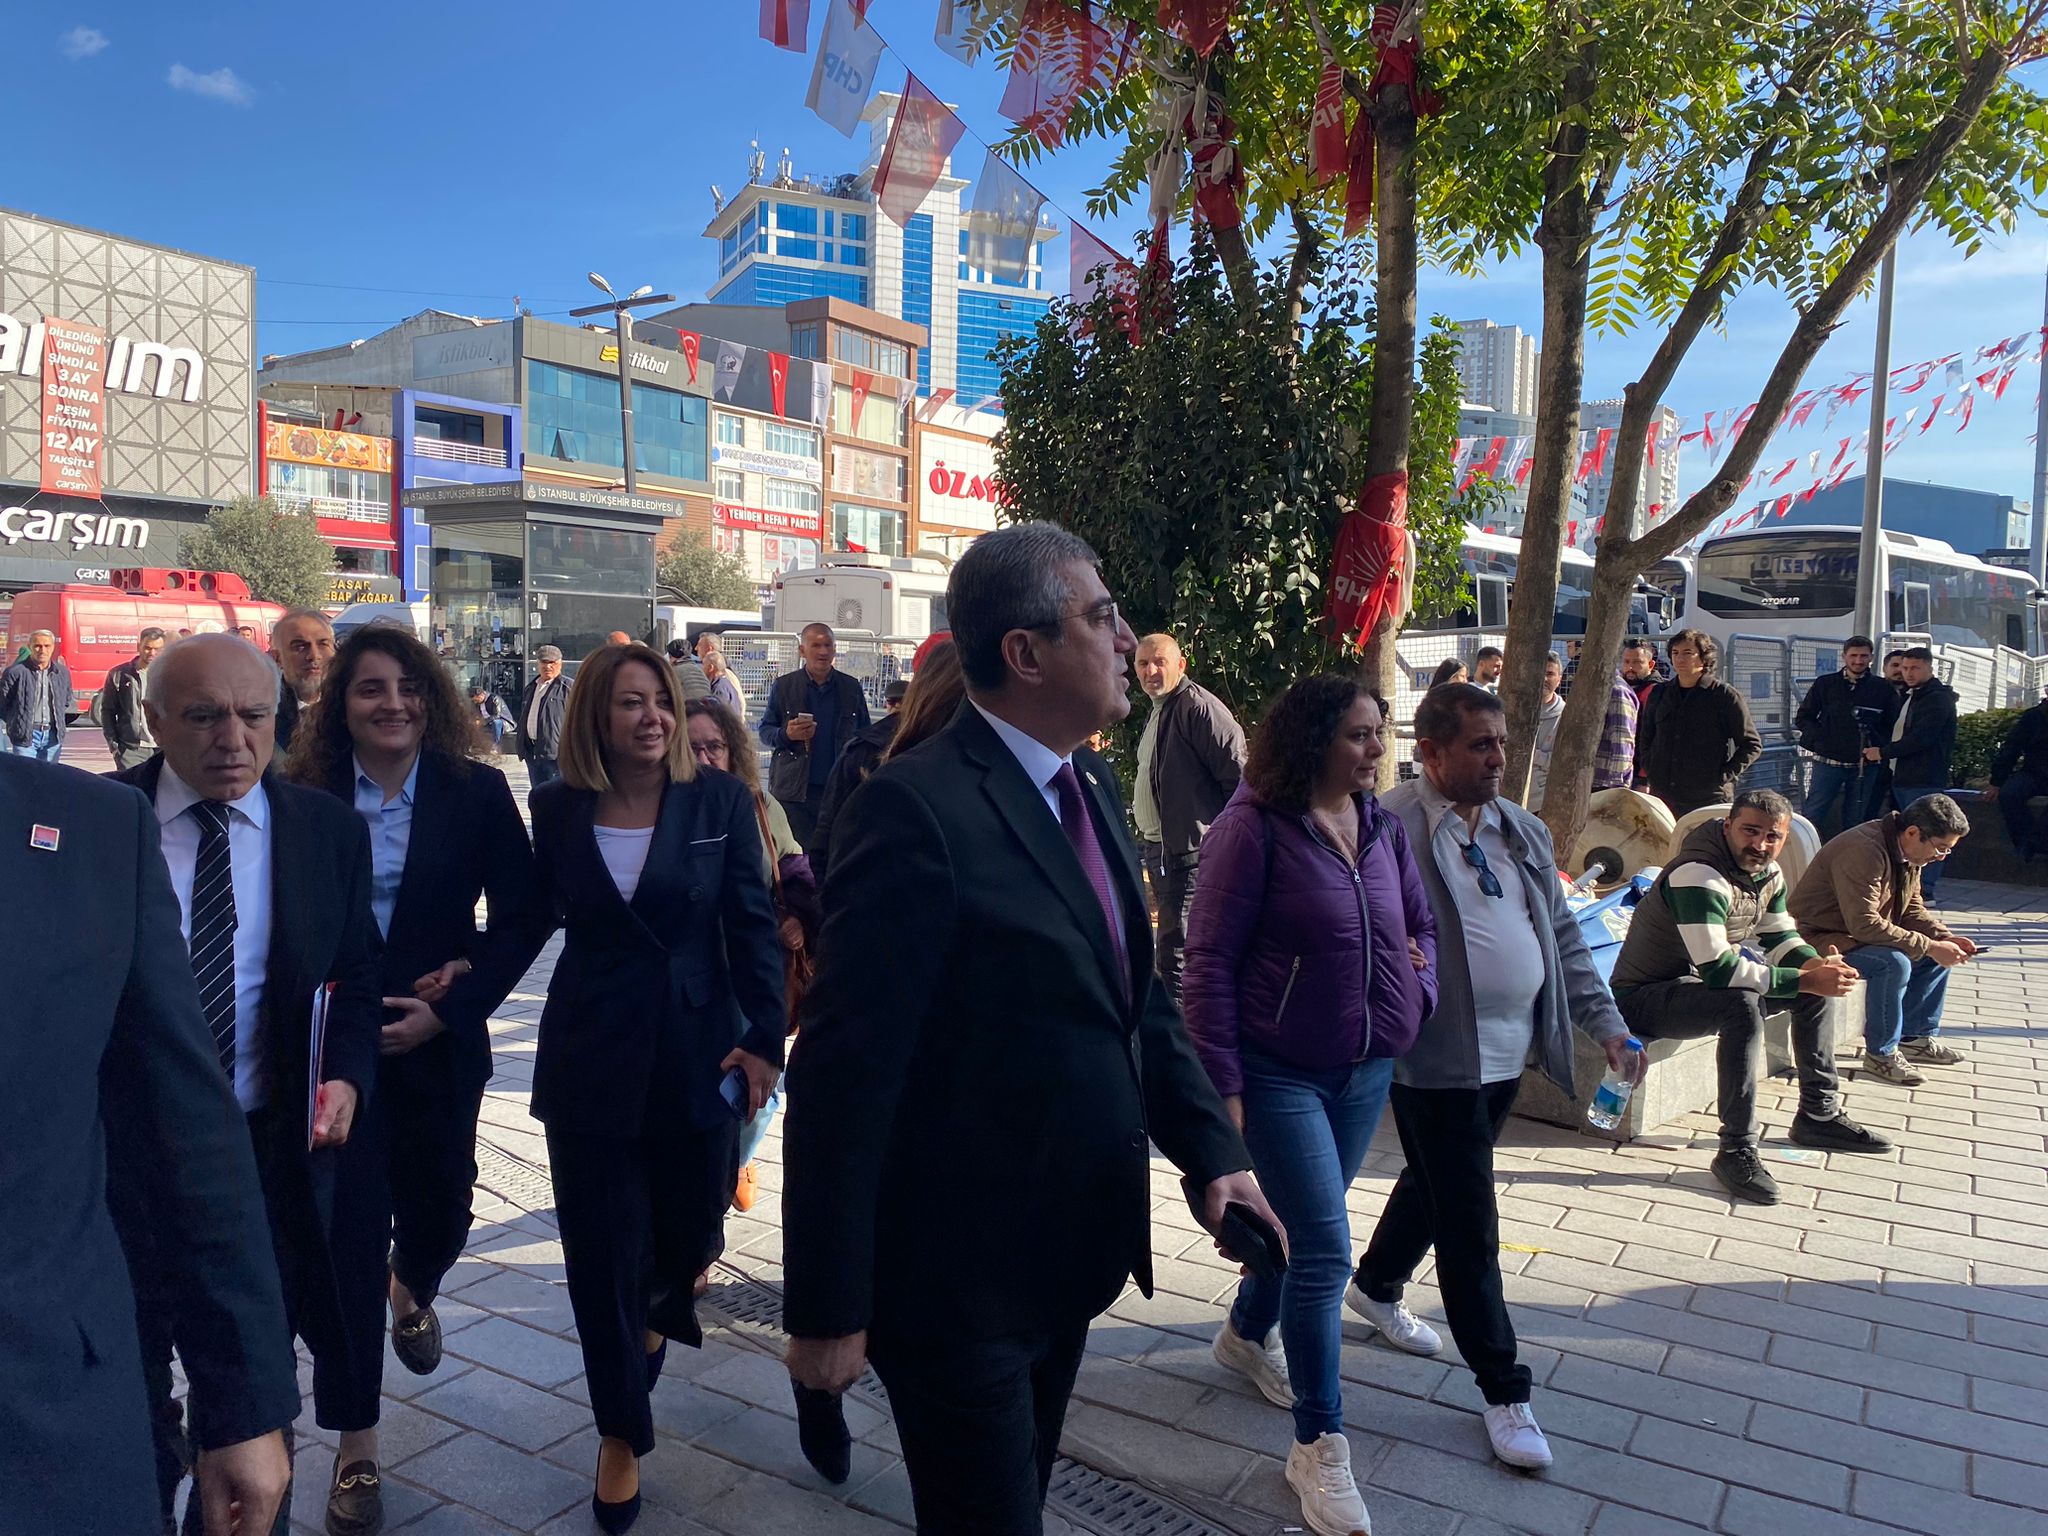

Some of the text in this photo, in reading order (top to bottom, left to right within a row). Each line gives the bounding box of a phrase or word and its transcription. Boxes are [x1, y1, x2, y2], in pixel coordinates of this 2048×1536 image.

[49, 326, 102, 346] DİLEDİĞİN
[56, 338, 95, 356] ÜRÜNÜ
[48, 353, 100, 372] ŞİMDİ AL
[58, 368, 92, 385] 3 AY
[47, 384, 100, 404] SONRA
[55, 403, 91, 419] PEŞİN
[46, 415, 98, 433] FİYATINA
[45, 431, 99, 454] 12 AY
[48, 454, 96, 469] TAKSİTLE
[61, 465, 82, 478] ÖDE
[55, 480, 88, 492] çarşım
[476, 484, 512, 498] BELEDİYESİ
[929, 460, 1008, 504] ÖZAY
[538, 487, 675, 513] İSTANBUL BÜYÜKŞEHİR BELEDİYESİ
[728, 507, 762, 523] YENİDEN
[764, 513, 788, 526] REFAH
[790, 517, 819, 531] PARTİSİ
[0, 506, 149, 551] çarşım
[75, 567, 110, 581] çarşı
[1761, 597, 1800, 606] OTOKAR
